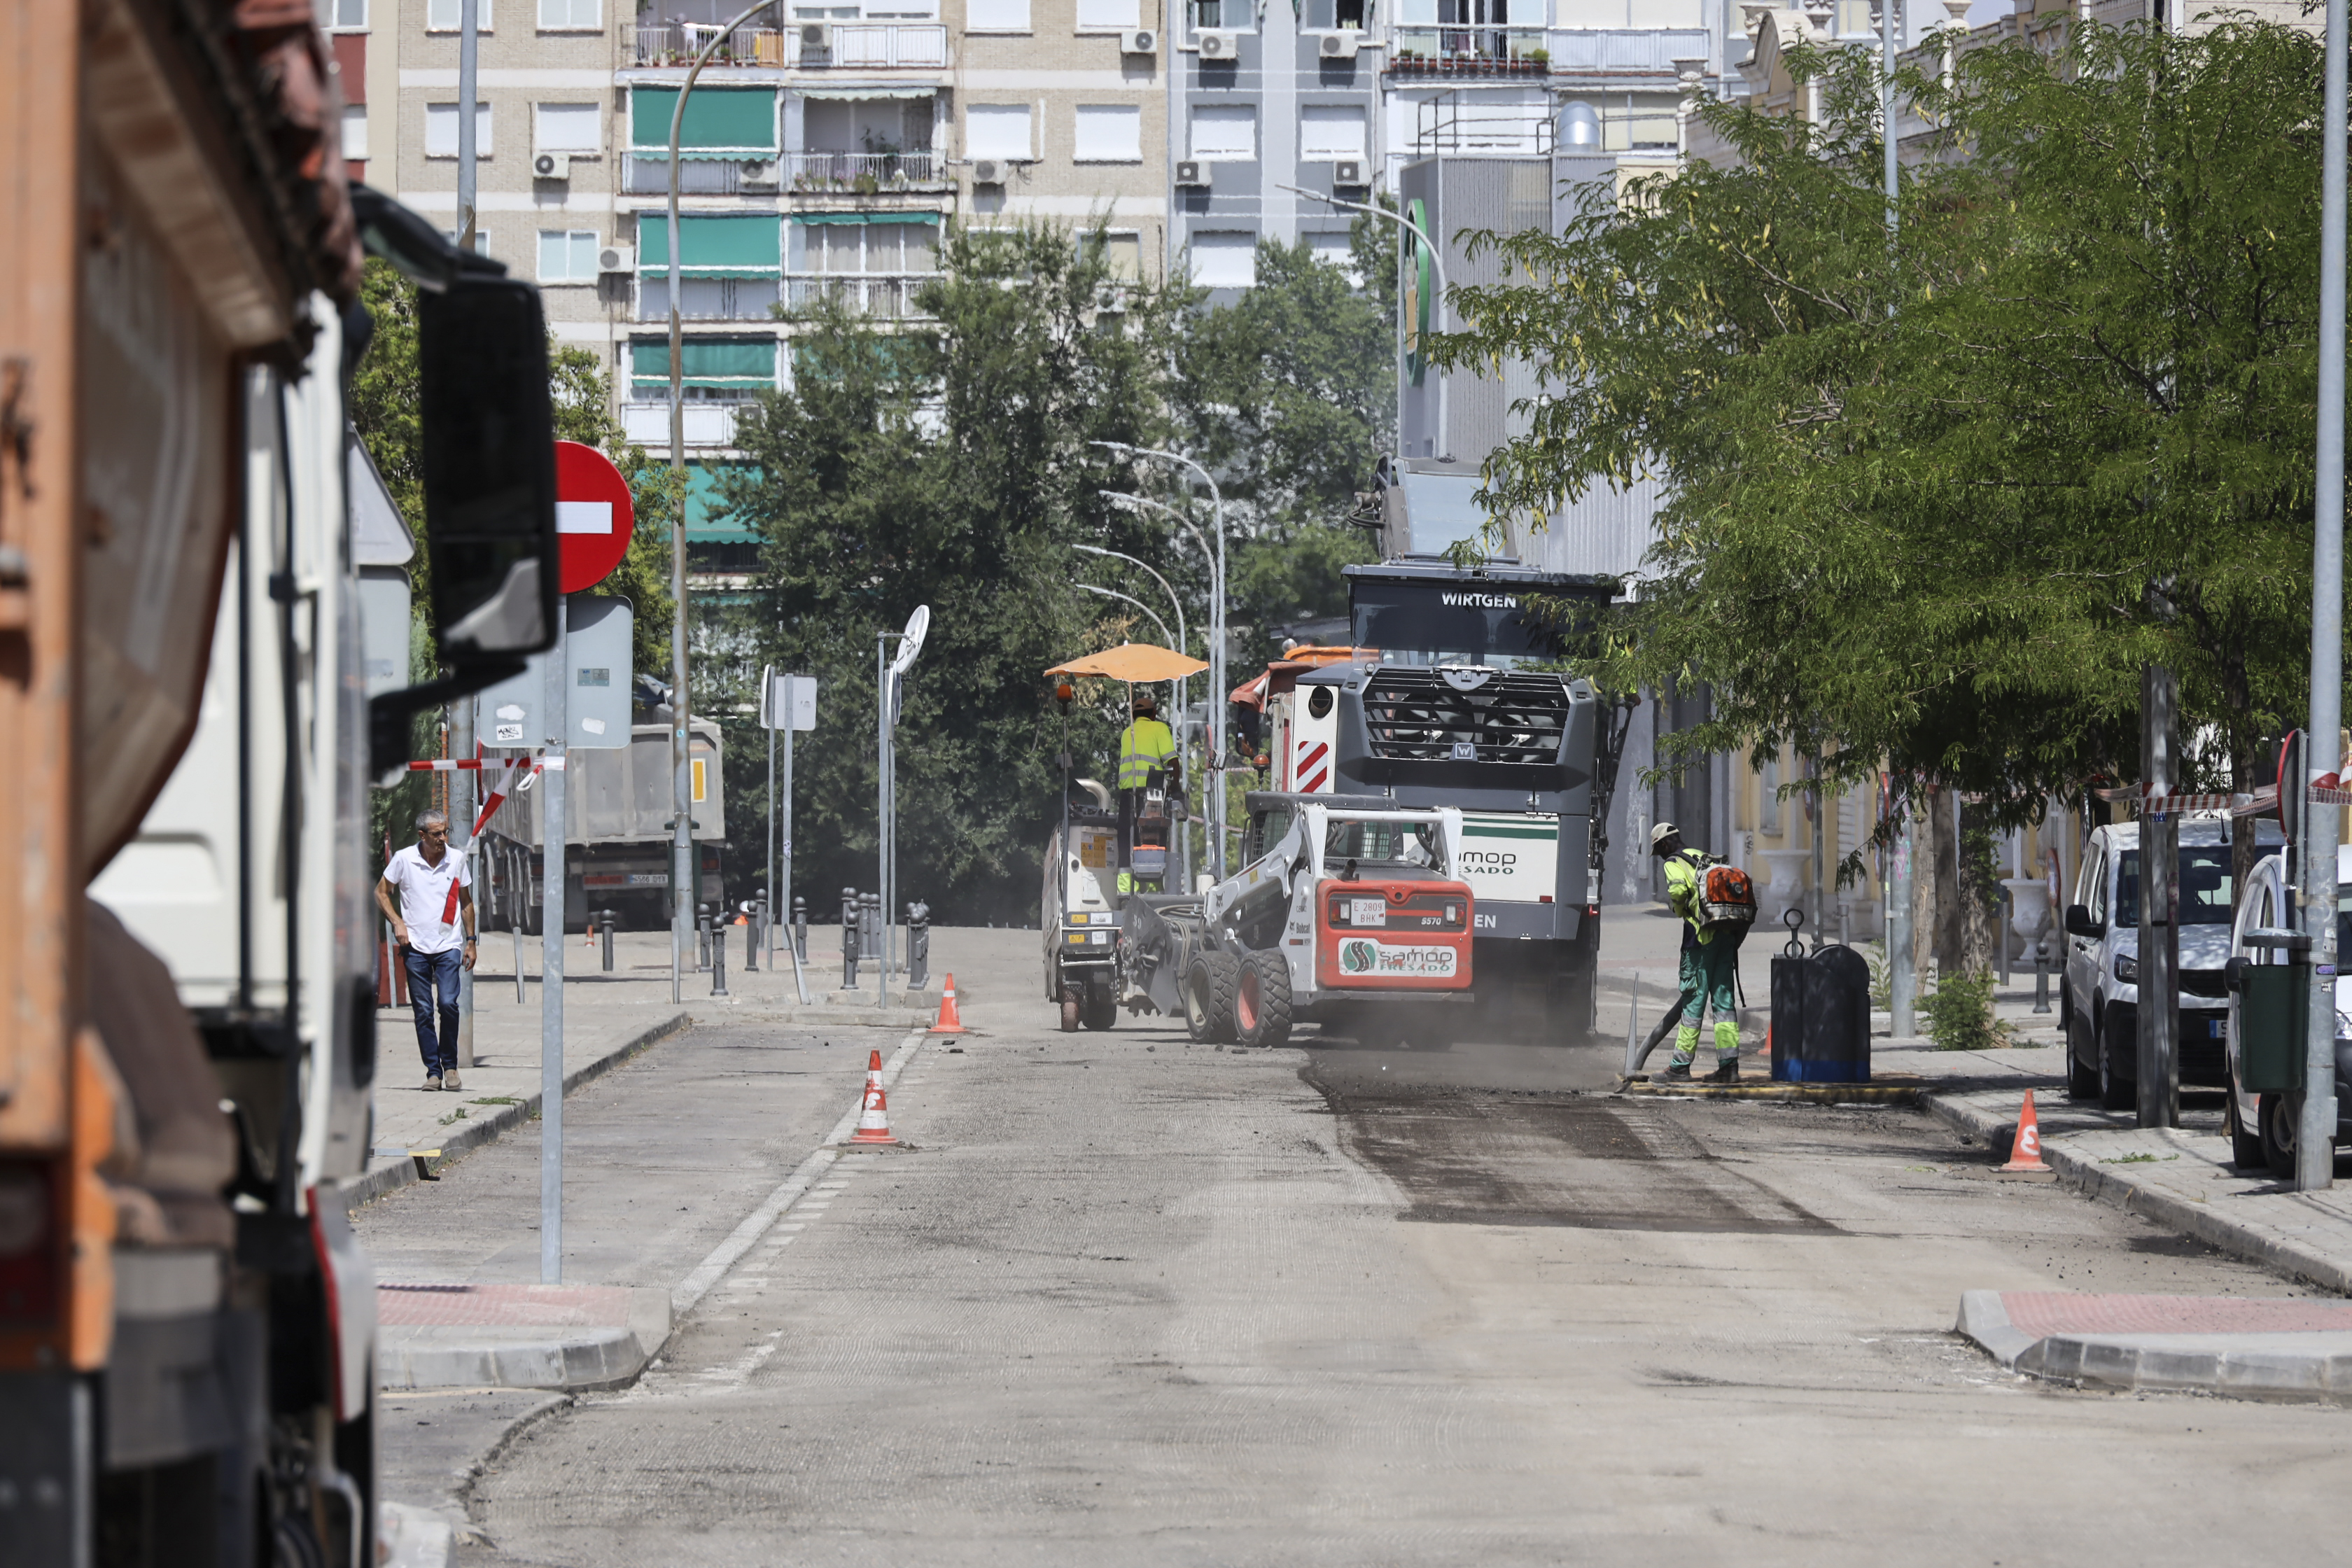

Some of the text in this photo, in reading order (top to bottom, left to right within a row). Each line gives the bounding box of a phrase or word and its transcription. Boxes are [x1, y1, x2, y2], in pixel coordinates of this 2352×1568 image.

[1442, 592, 1516, 608] WIRTGEN
[1459, 852, 1516, 867] mop
[1459, 866, 1514, 875] SADO
[1354, 902, 1382, 911] E 2809
[1360, 913, 1376, 923] BHK
[1421, 917, 1441, 925] S570
